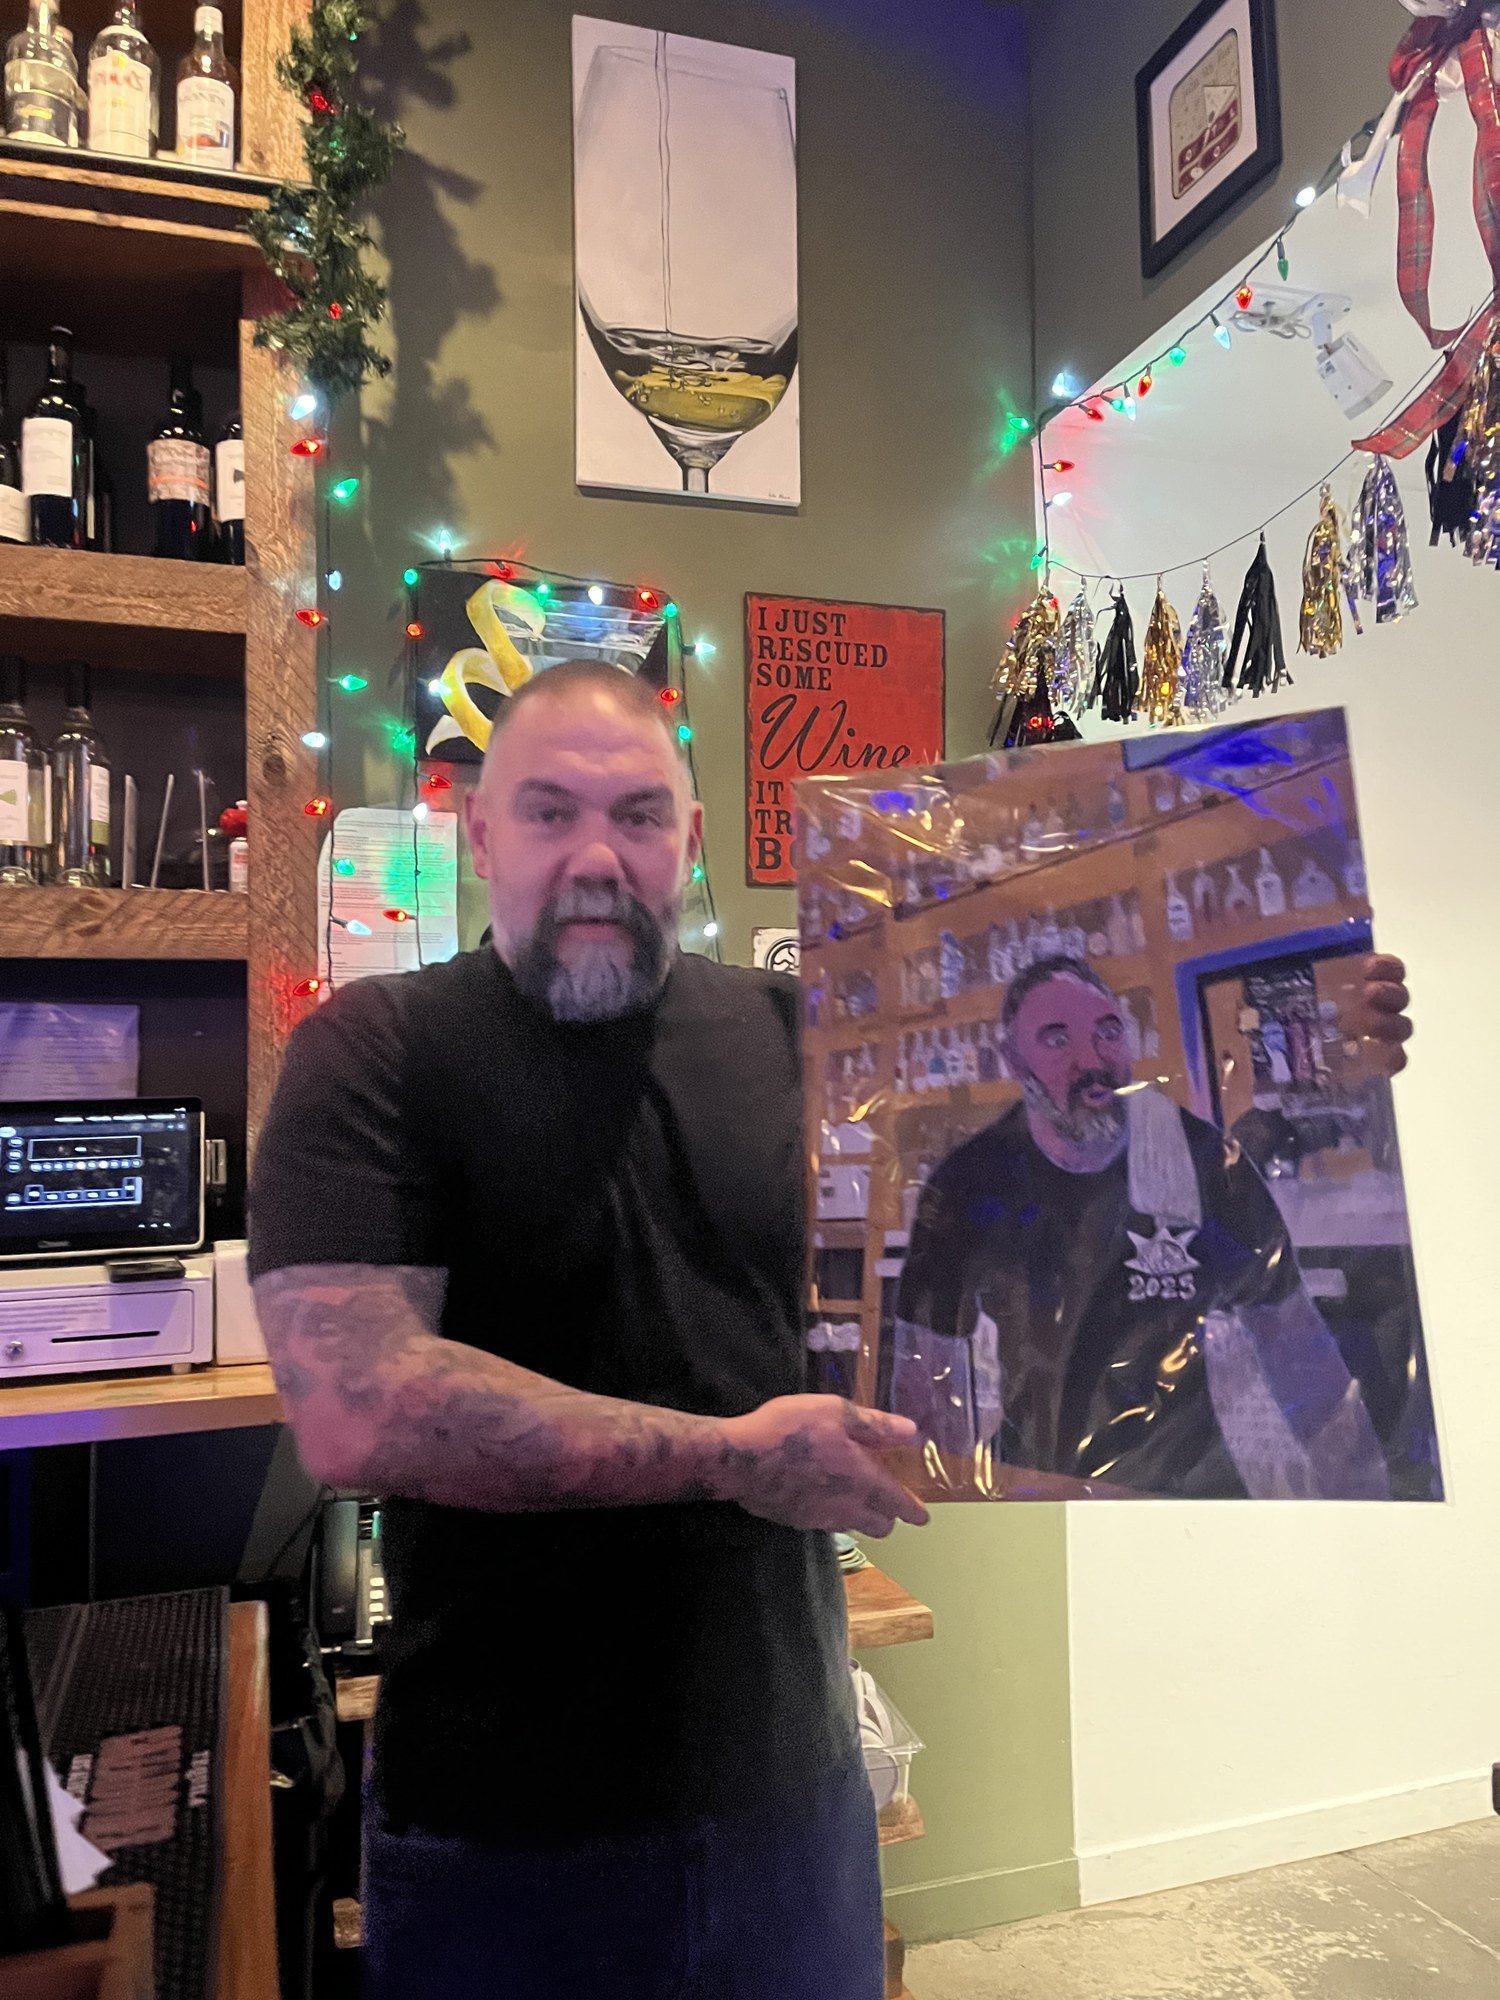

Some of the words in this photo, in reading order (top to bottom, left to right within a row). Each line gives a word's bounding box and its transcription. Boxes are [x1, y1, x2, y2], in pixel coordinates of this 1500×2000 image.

[758, 606, 768, 631] I
[775, 608, 846, 636] JUST
[757, 635, 888, 668] RESCUED
[756, 662, 832, 691] SOME
[759, 693, 911, 772] Wine
[755, 780, 784, 805] IT
[754, 809, 794, 835] TR
[1128, 1273, 1197, 1300] 2025
